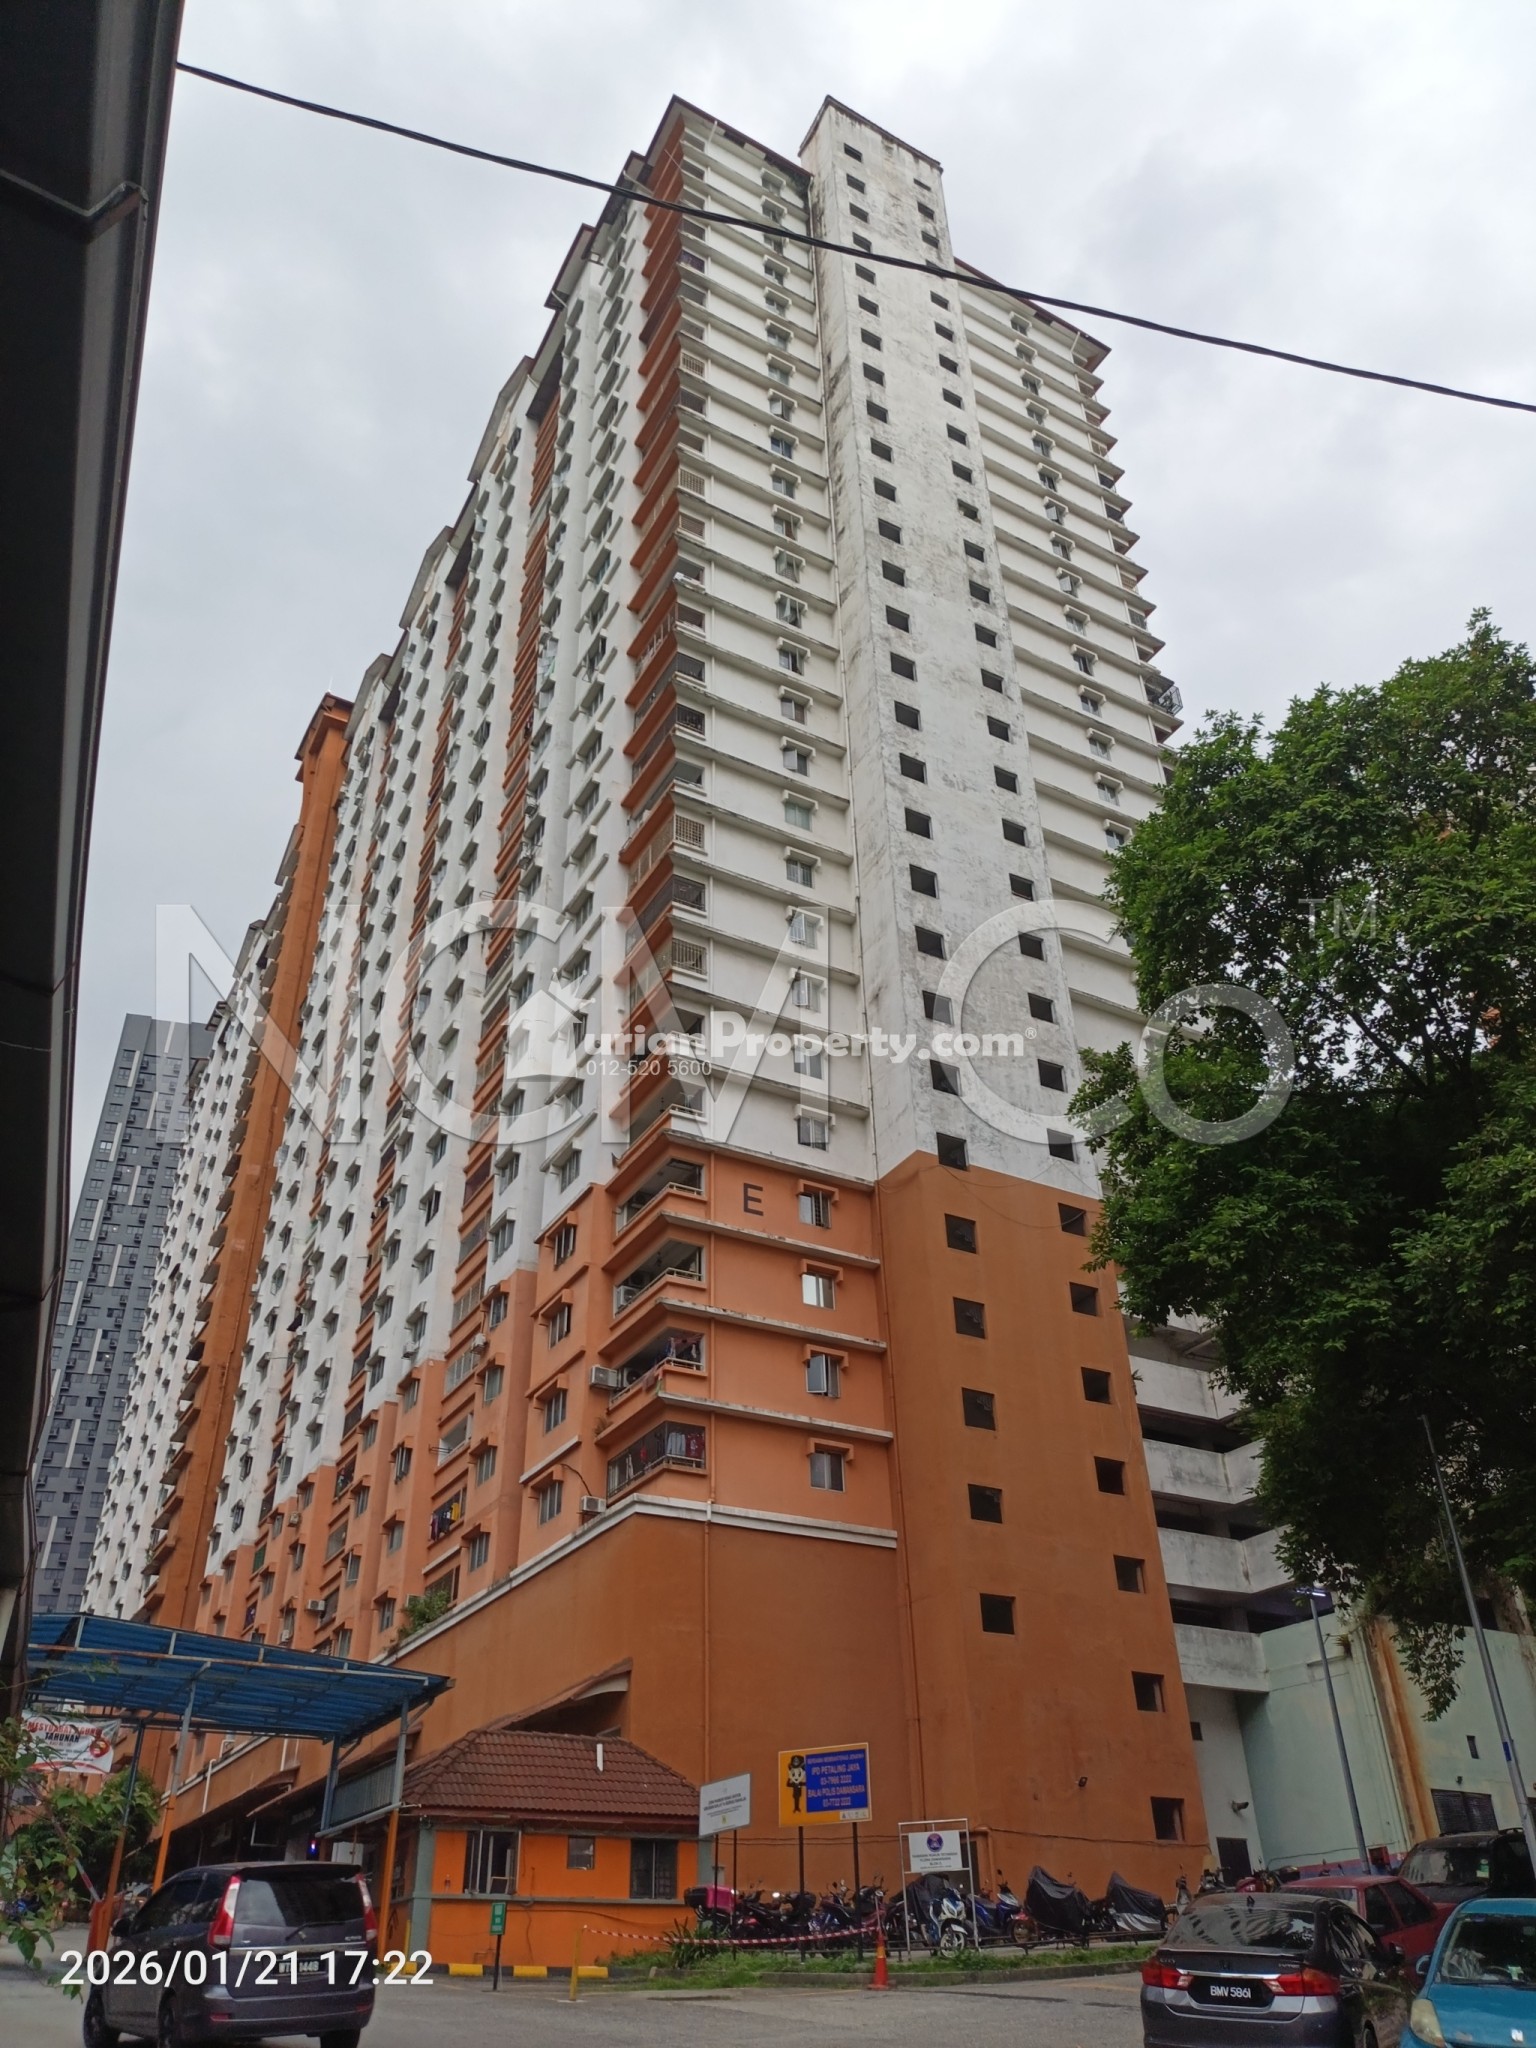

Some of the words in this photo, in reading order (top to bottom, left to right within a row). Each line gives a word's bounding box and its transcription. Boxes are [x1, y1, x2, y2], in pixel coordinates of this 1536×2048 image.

[743, 1182, 764, 1217] E
[45, 1732, 80, 1743] TAHUNAN
[811, 1766, 821, 1776] IPD
[821, 1763, 847, 1775] PETALING
[847, 1762, 860, 1772] JAYA
[807, 1788, 822, 1798] BALAI
[822, 1787, 836, 1796] POLIS
[836, 1784, 865, 1795] DAMANSARA
[1210, 1985, 1229, 1997] BMV
[1230, 1987, 1252, 1999] 5861
